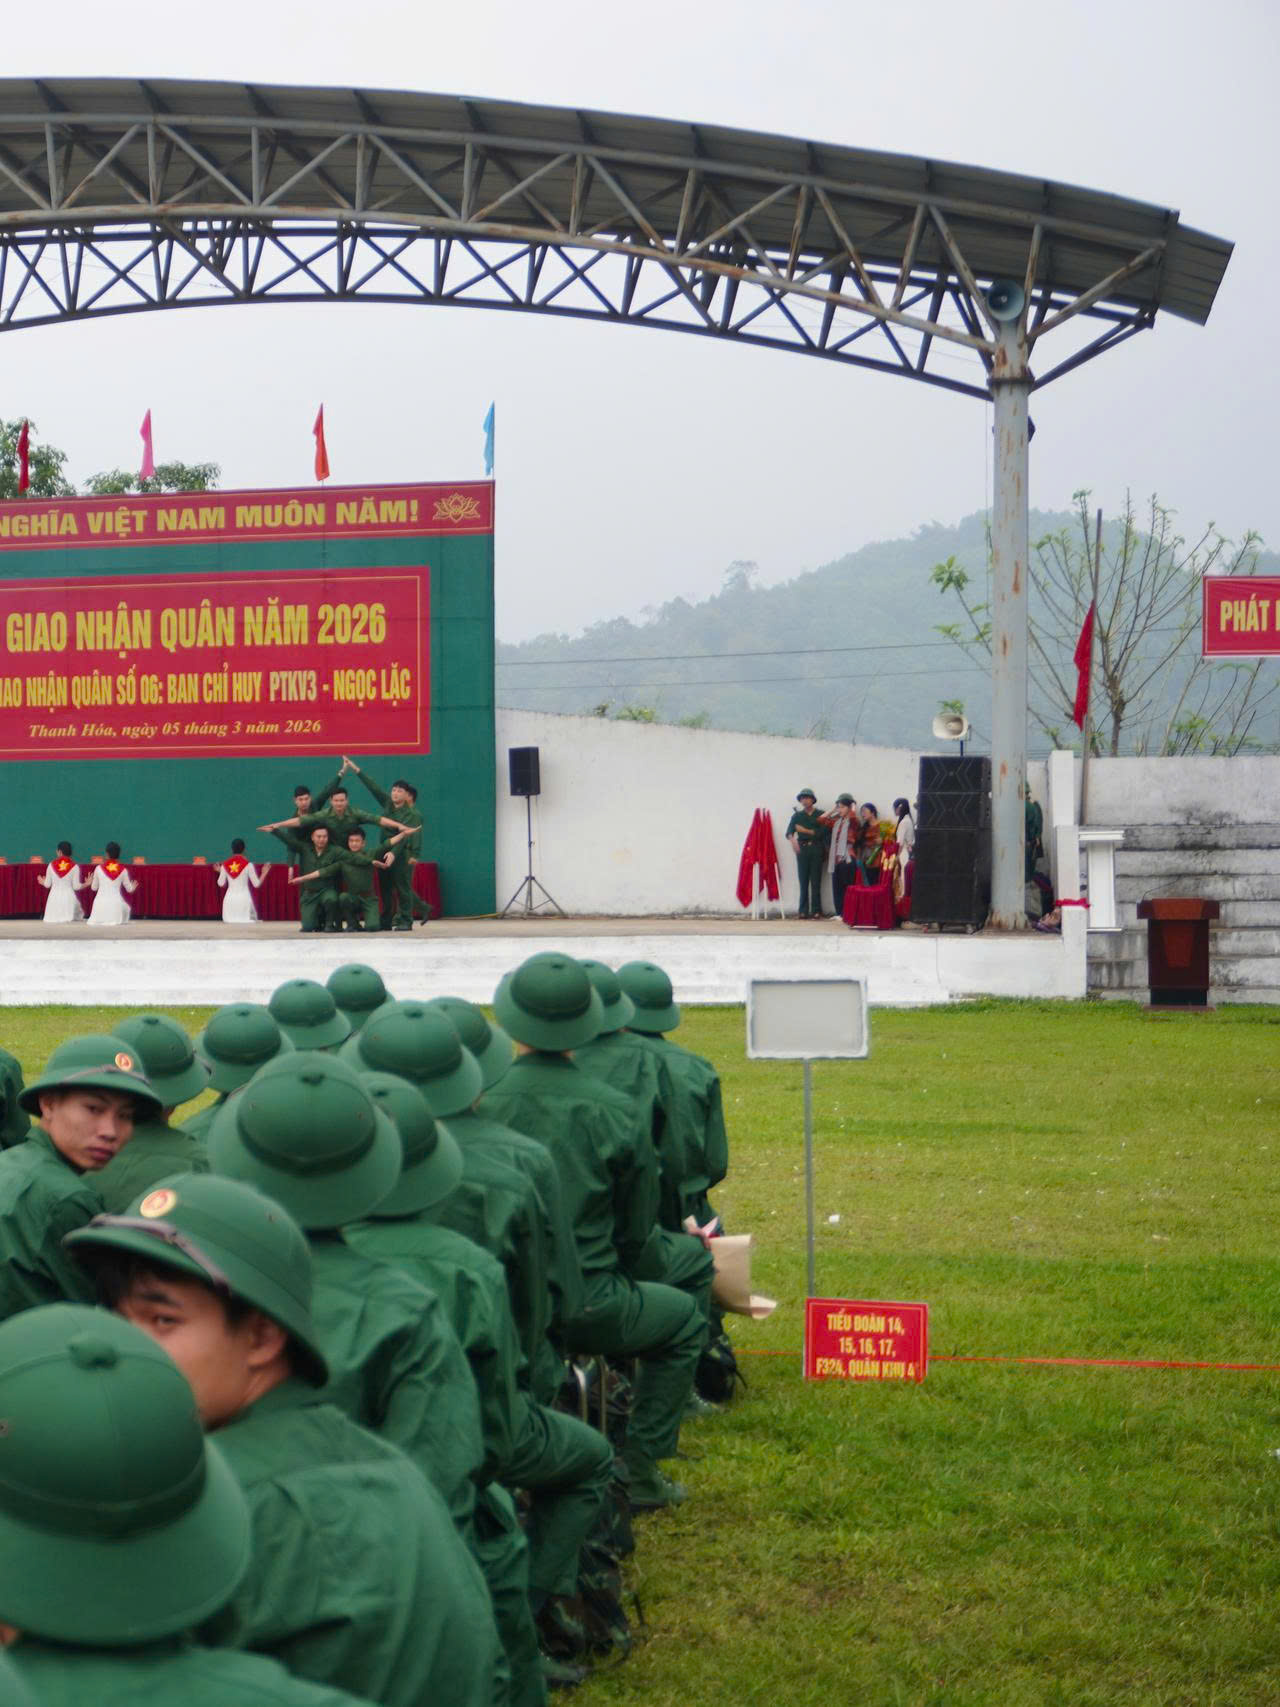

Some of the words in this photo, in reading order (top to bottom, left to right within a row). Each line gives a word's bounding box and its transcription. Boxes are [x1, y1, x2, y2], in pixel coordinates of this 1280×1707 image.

[86, 506, 148, 538] VIỆT
[157, 507, 225, 532] NAM
[235, 499, 326, 528] MUÔN
[336, 496, 419, 524] NĂM!
[6, 611, 68, 653] GIAO
[76, 600, 152, 659] NHẬN
[160, 598, 235, 653] QUÂN
[243, 596, 309, 646] NĂM
[317, 603, 387, 644] 2026
[1220, 593, 1270, 632] PHÁT
[26, 670, 68, 713] NHẬN
[71, 669, 112, 710] QUÂN
[116, 664, 136, 705] SỐ
[140, 674, 163, 704] 06:
[167, 673, 199, 704] BAN
[202, 662, 229, 703] CHỈ
[232, 671, 262, 702] HUY
[270, 670, 317, 702] PTKV3
[333, 668, 377, 707] NGỌC
[381, 662, 411, 707] LẶC
[29, 724, 76, 737] Thanh
[81, 723, 117, 737] Hóa,
[121, 723, 158, 738] ngày
[162, 722, 180, 735] 05
[184, 720, 228, 737] tháng
[232, 720, 241, 733] 3
[245, 721, 279, 733] năm
[284, 719, 322, 733] 2026
[888, 1317, 905, 1336] 14,
[839, 1337, 857, 1356] 15,
[859, 1338, 876, 1356] 16,
[879, 1339, 897, 1358] 17,
[849, 1357, 879, 1377] QUÂN
